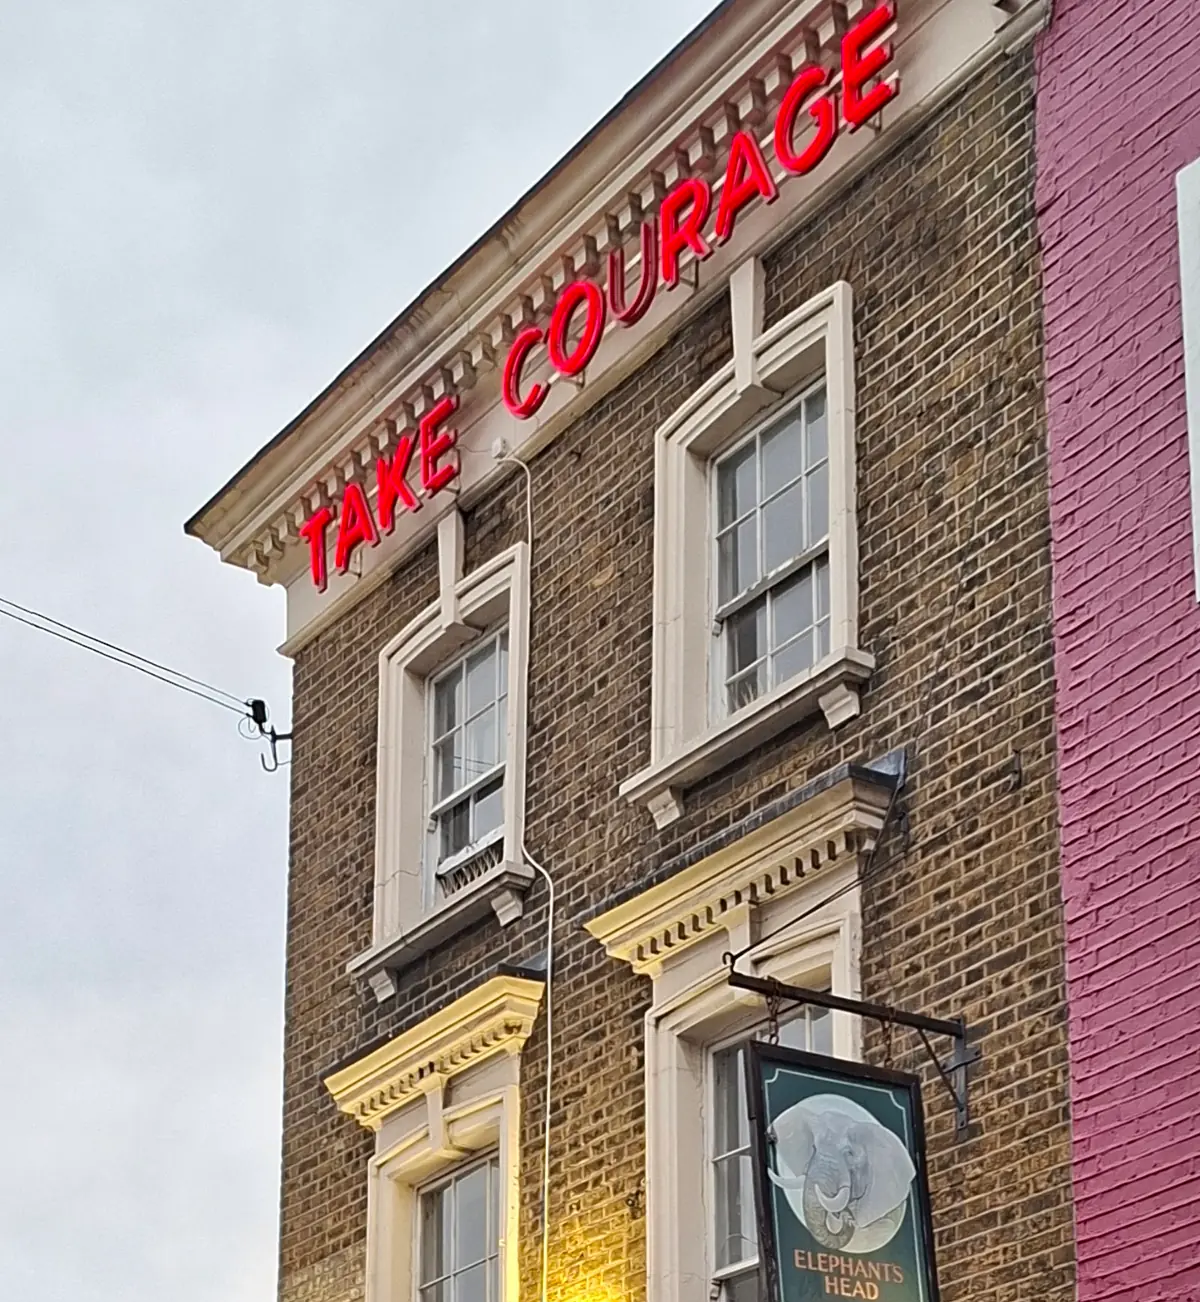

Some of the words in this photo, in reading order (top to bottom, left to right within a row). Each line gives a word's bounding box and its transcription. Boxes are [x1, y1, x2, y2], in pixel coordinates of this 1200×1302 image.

[301, 395, 460, 592] TAKE
[504, 2, 899, 420] COURAGE
[824, 1275, 880, 1301] HEAD
